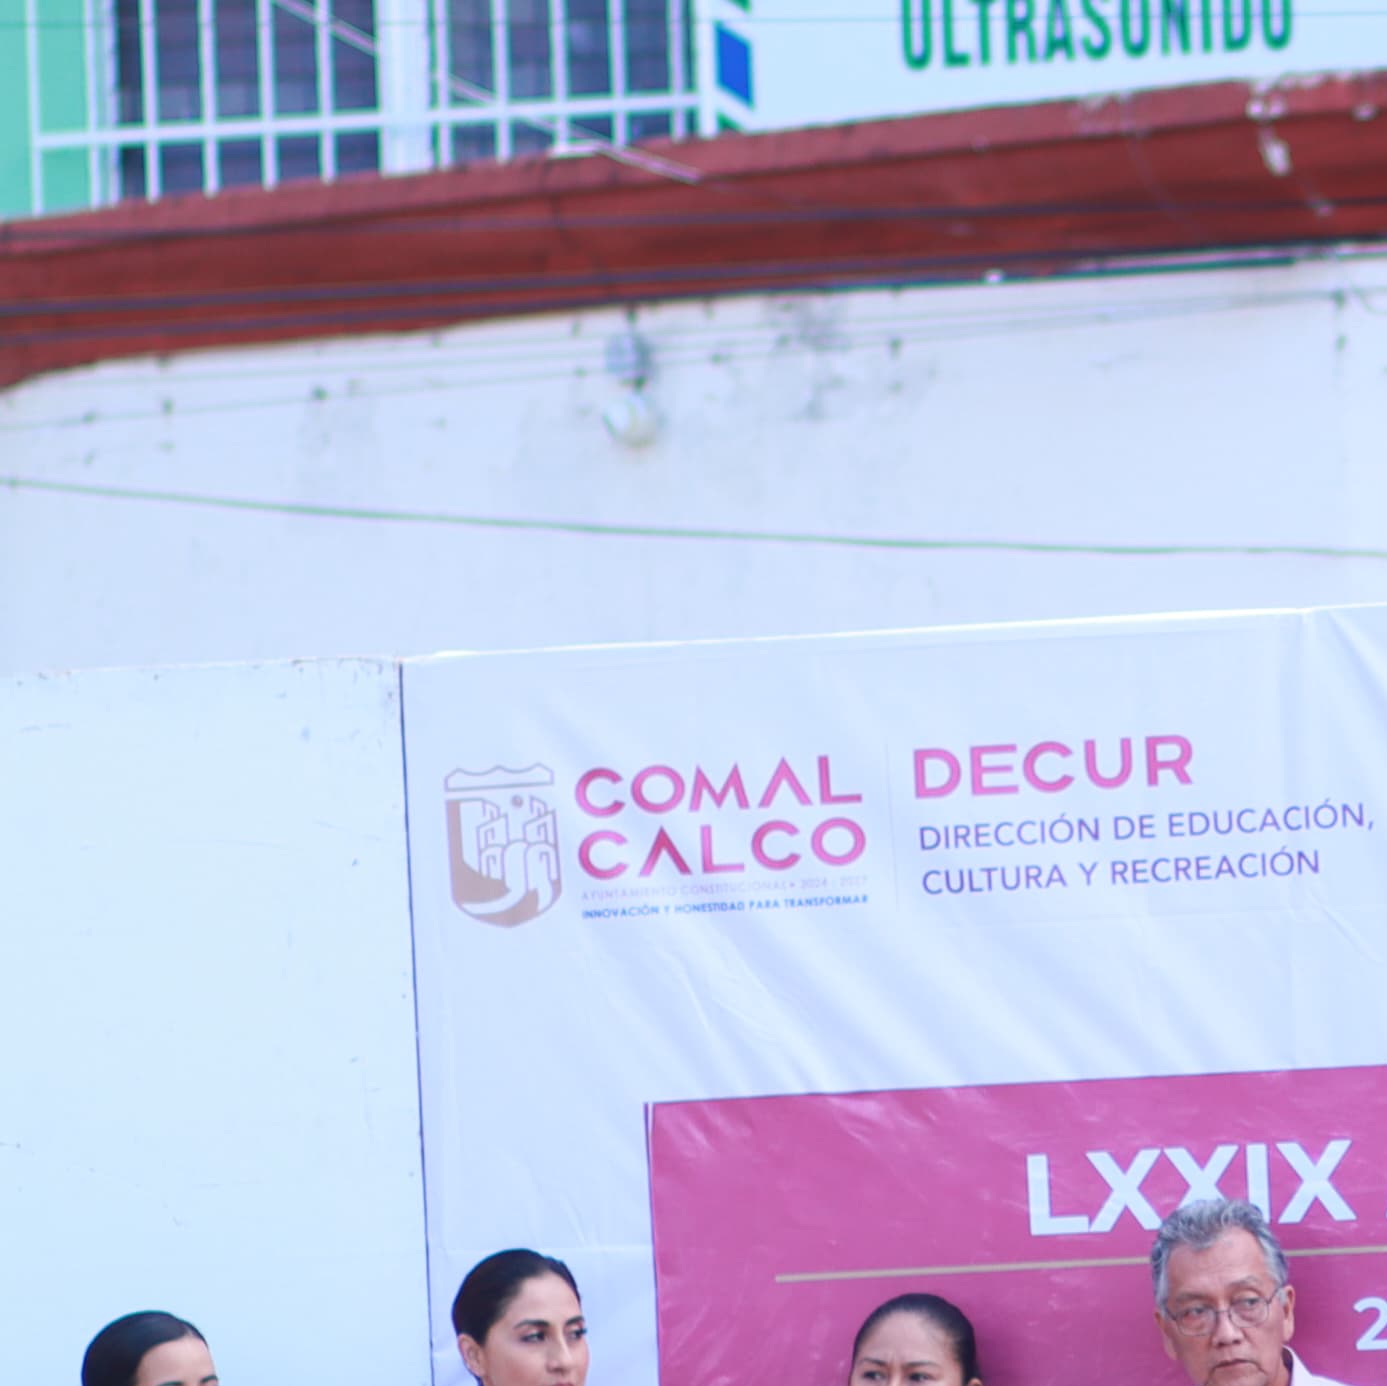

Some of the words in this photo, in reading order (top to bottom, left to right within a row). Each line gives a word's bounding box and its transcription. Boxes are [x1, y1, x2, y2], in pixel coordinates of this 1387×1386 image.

[902, 0, 1292, 70] ULTRASONIDO
[574, 755, 863, 818] COMAL
[913, 735, 1194, 799] DECUR
[578, 817, 867, 880] CALCO
[919, 813, 1101, 851] DIRECCIÓN
[1113, 814, 1157, 841] DE
[1168, 798, 1374, 838] EDUCACIÓN,
[922, 864, 1067, 895] CULTURA
[1079, 862, 1099, 886] Y
[1110, 846, 1320, 885] RECREACIÓN
[581, 903, 660, 920] INNOVACIÓN
[674, 901, 746, 915] HONESTIDAD
[748, 899, 781, 911] PARA
[784, 894, 869, 908] TRANSFORMAR
[1026, 1139, 1358, 1236] LXXIX
